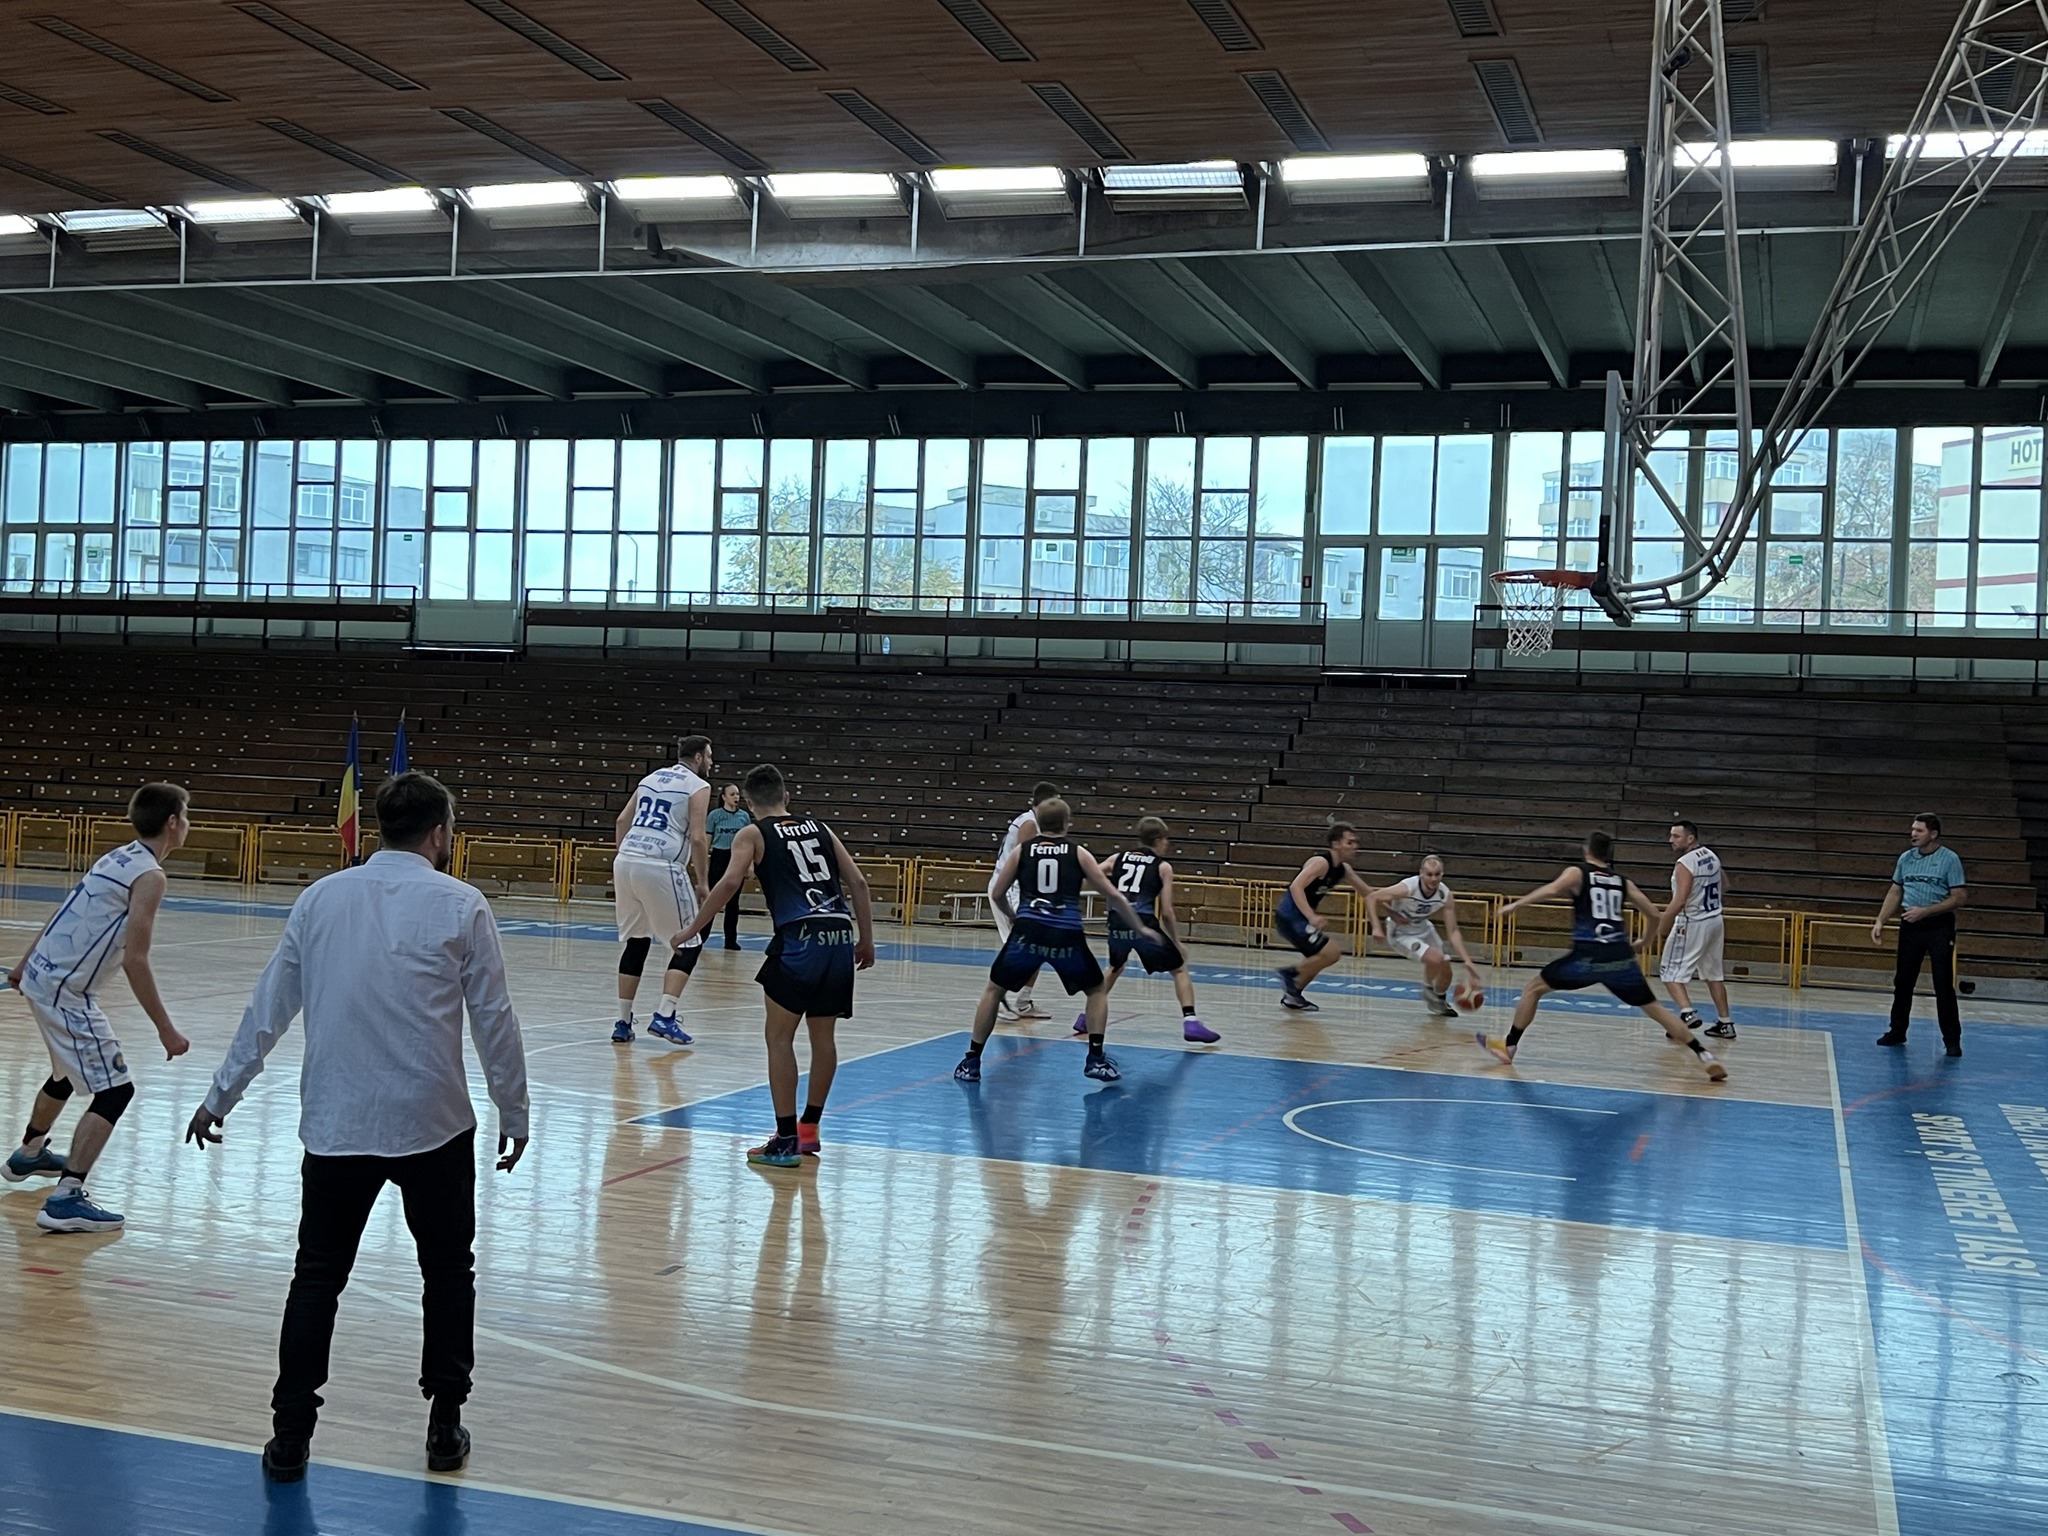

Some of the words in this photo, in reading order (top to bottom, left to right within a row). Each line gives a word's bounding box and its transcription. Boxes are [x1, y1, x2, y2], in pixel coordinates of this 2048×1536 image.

[2011, 439, 2043, 465] HOT
[1348, 775, 1355, 787] 8
[633, 796, 672, 831] 35
[1336, 792, 1345, 804] 7
[1326, 812, 1335, 824] 6
[787, 838, 831, 882] 15
[1037, 858, 1058, 894] 0
[1118, 862, 1146, 893] 21
[1589, 887, 1624, 921] 80
[817, 929, 856, 946] SWE
[1029, 943, 1074, 958] SWEAT
[1911, 1112, 1977, 1151] SPORT
[1930, 1166, 2020, 1234] TINERET
